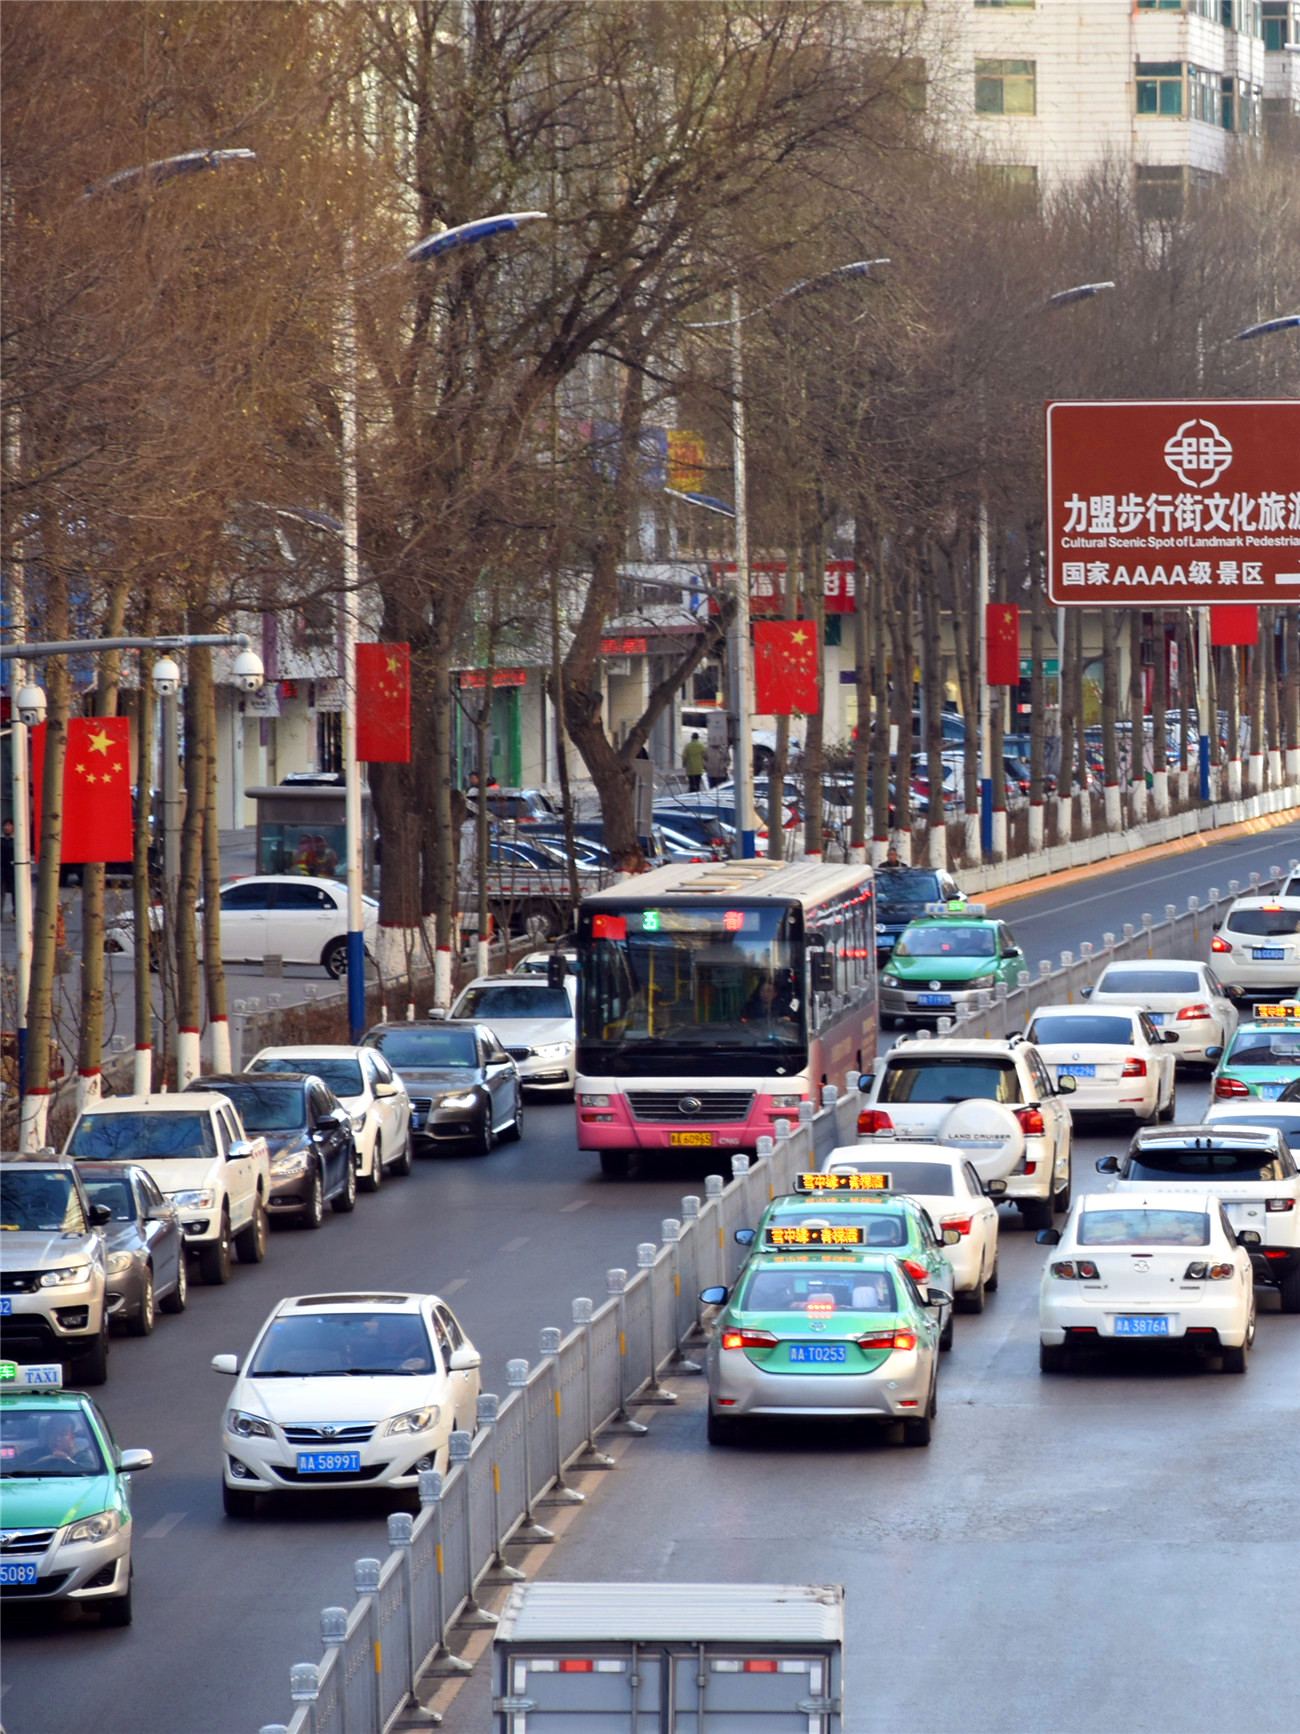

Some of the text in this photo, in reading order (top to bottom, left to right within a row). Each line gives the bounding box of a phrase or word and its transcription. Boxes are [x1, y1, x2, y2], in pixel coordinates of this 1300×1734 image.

[1061, 536, 1107, 549] Cultural
[1108, 536, 1147, 549] Scenic
[1147, 536, 1175, 550] Spot
[1176, 536, 1189, 549] of
[1189, 536, 1244, 548] Landmark
[1061, 560, 1264, 586] 国家AAAA级景区
[25, 1371, 58, 1384] TAXI
